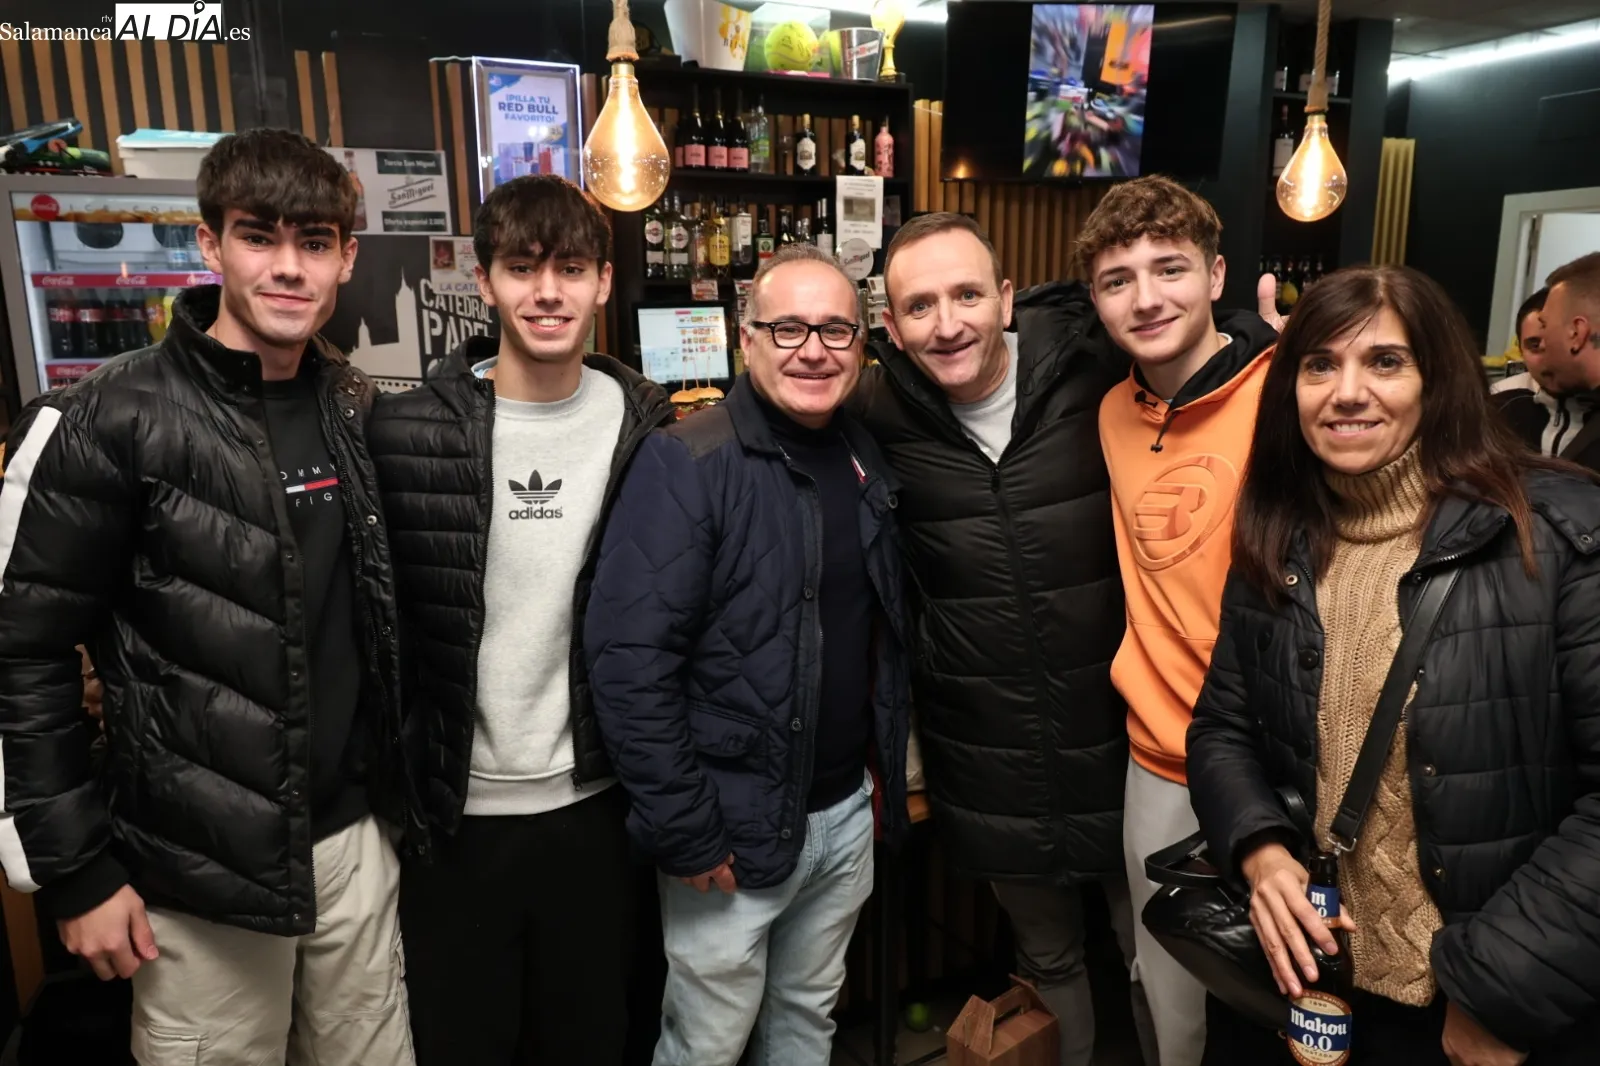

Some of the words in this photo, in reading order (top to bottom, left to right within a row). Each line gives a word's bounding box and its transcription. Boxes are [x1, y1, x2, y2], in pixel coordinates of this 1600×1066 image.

[498, 101, 524, 112] RED
[527, 103, 558, 115] BULL
[504, 113, 555, 123] FAVORITO!
[42, 276, 74, 286] Coca-Cola
[116, 275, 147, 286] Coca-Cola
[440, 283, 452, 292] LA
[455, 283, 480, 292] CATE
[420, 278, 493, 323] CATEDRAL
[296, 492, 333, 507] FIG
[508, 506, 563, 520] adidas
[1291, 1007, 1347, 1035] Mahou
